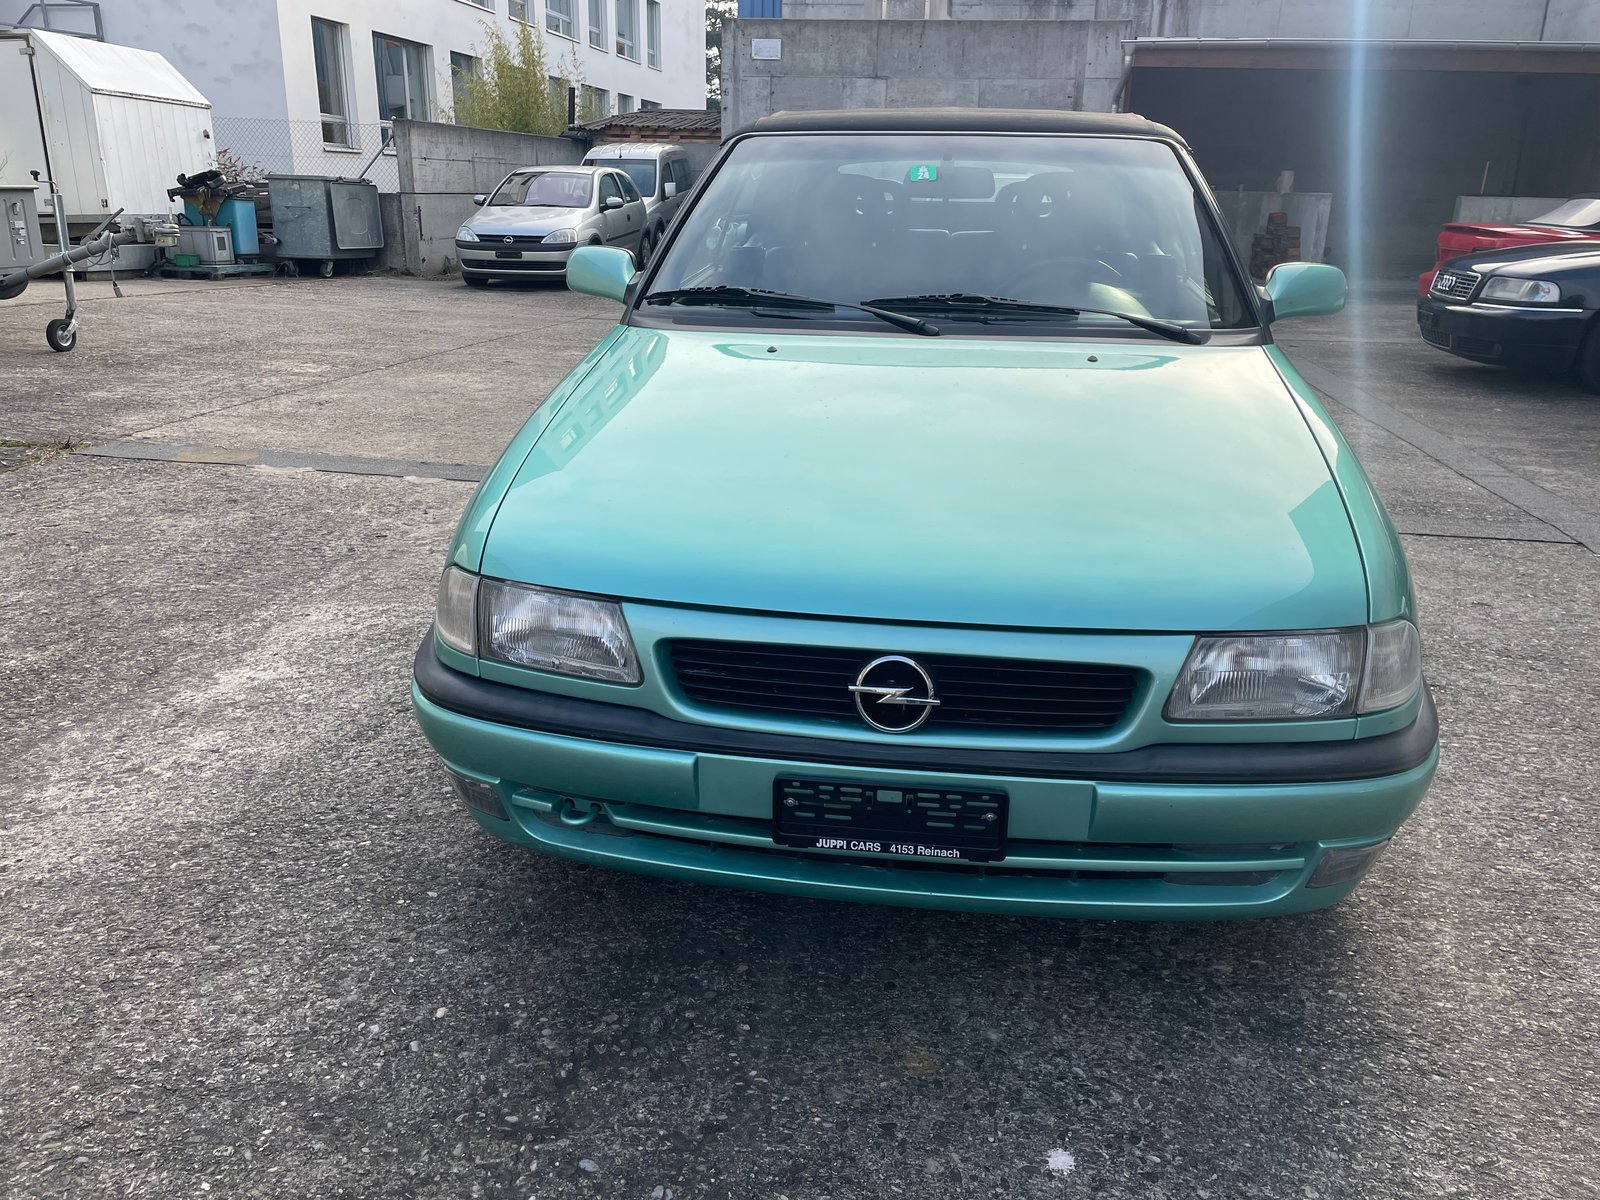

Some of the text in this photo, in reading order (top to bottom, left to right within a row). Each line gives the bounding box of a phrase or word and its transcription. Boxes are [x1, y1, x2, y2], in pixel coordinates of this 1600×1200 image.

[816, 838, 960, 858] JUPPI CARS 4153 Reinach
